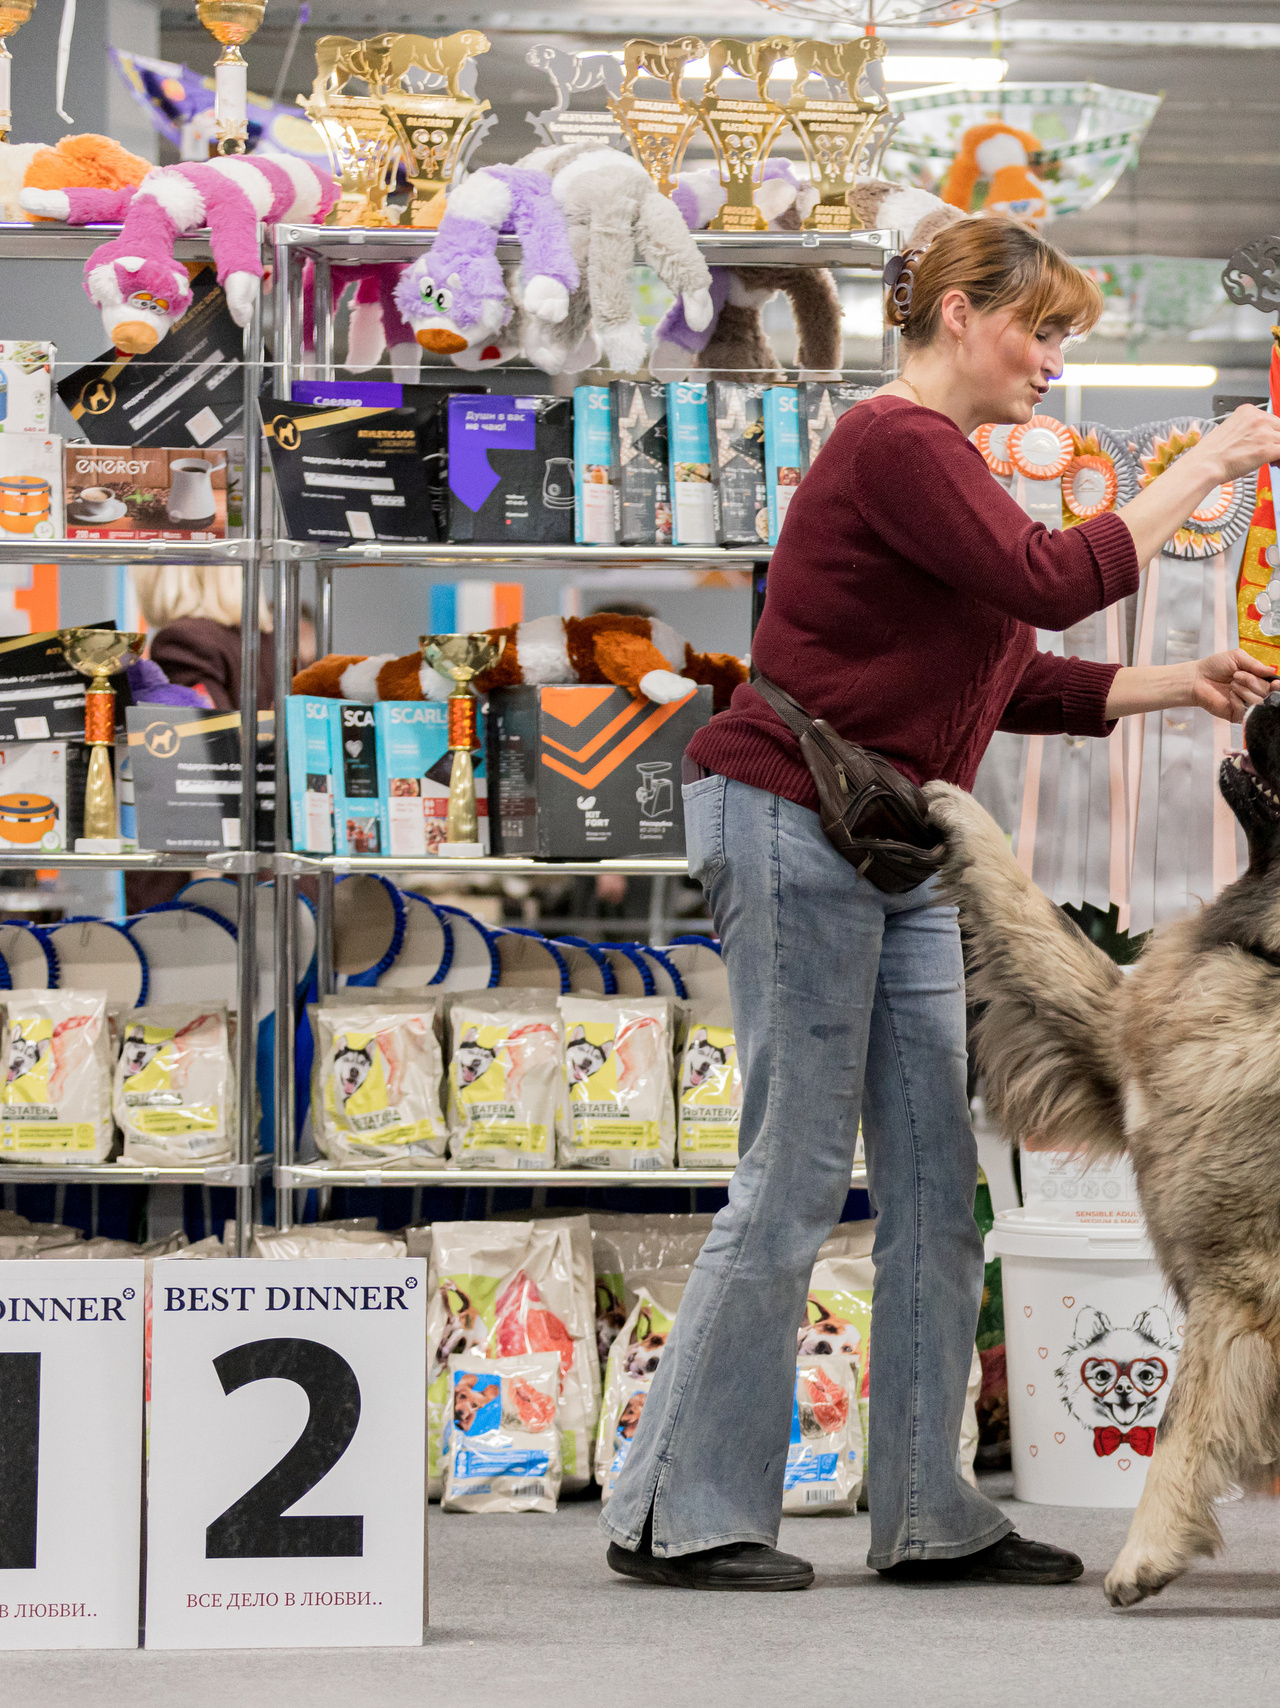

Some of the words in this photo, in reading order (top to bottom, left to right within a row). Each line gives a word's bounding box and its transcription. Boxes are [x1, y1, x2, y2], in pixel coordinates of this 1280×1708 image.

[313, 396, 363, 407] Сделаю
[465, 411, 496, 423] Души
[506, 413, 526, 421] вас
[585, 819, 610, 827] FORT
[472, 1104, 515, 1113] TATERA
[164, 1286, 256, 1313] BEST
[265, 1285, 409, 1312] DINNER
[205, 1336, 364, 1559] 2
[186, 1593, 223, 1608] ВСЕ
[226, 1592, 280, 1611] ДЕЛО
[284, 1592, 296, 1607] В
[301, 1591, 383, 1608] ЛЮБВИ..
[14, 1602, 97, 1619] ЛЮБВИ..
